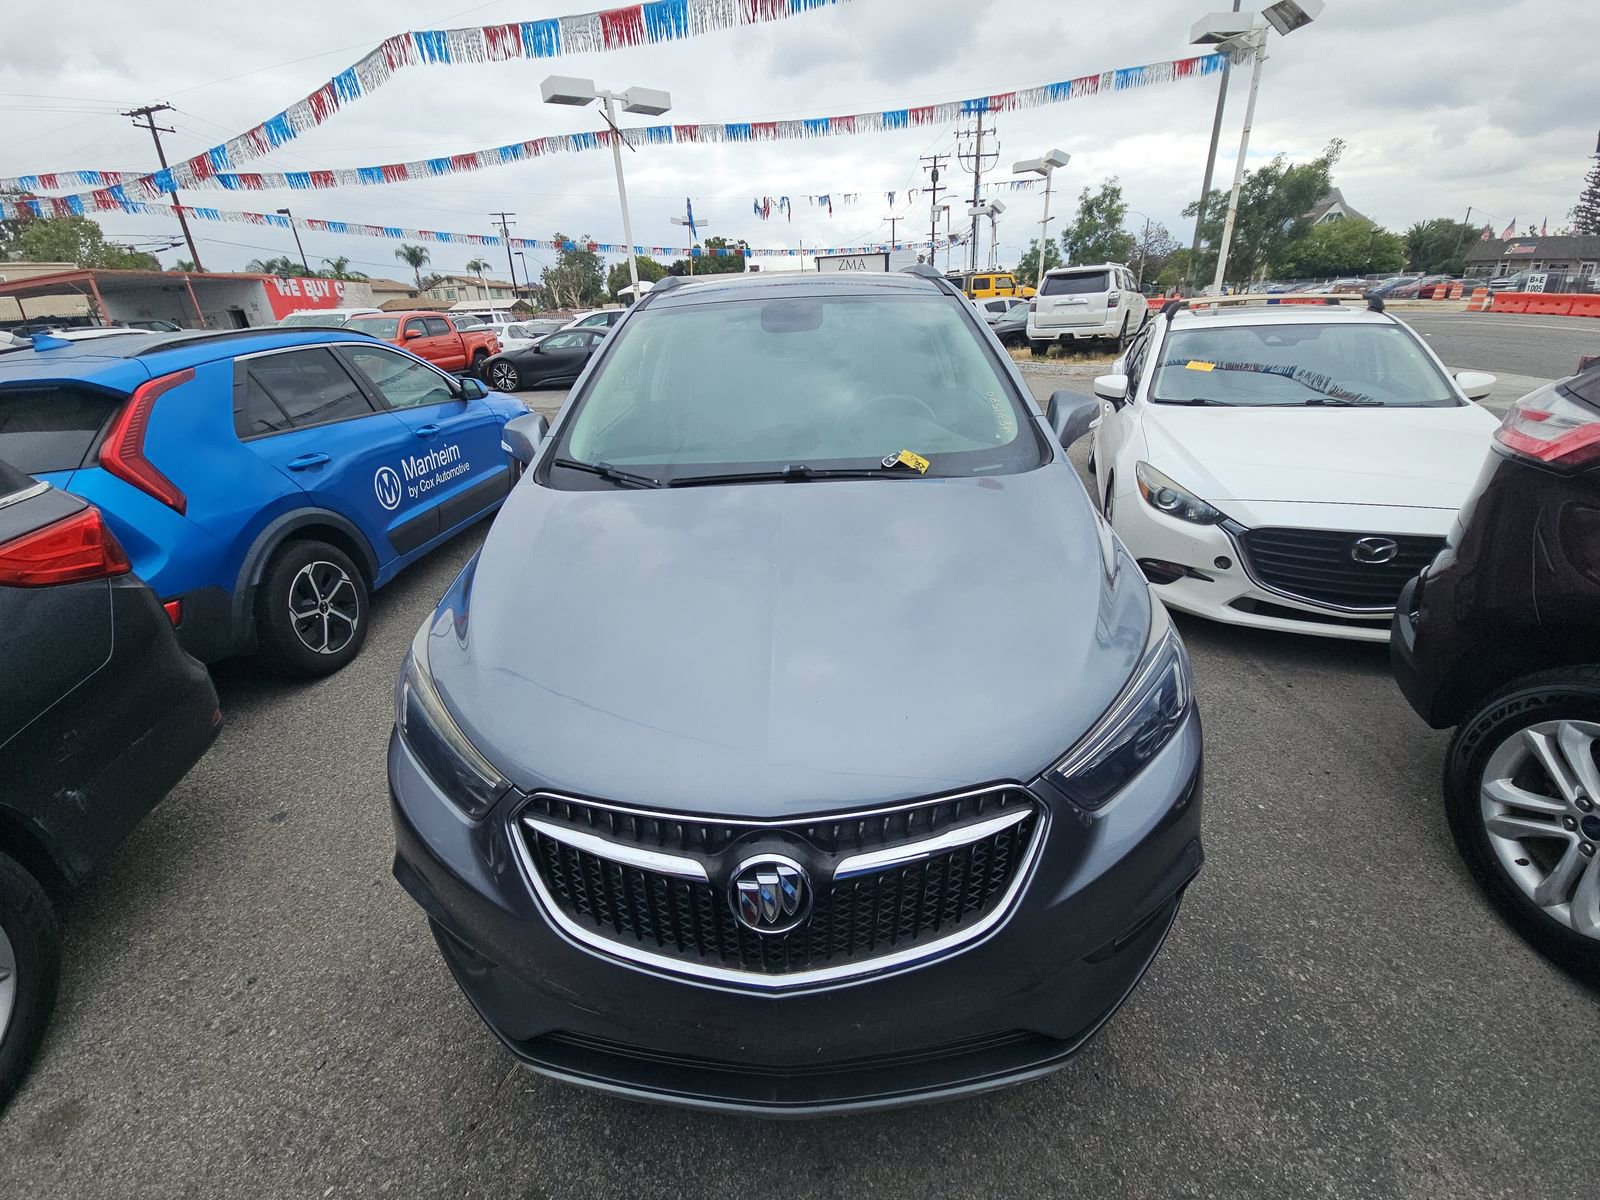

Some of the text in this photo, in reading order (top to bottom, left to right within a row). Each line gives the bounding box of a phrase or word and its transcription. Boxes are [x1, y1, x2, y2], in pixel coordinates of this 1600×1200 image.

[838, 258, 866, 271] ZMA
[273, 278, 301, 296] WE
[302, 279, 331, 297] BUY
[1526, 284, 1543, 293] 1005
[401, 444, 460, 481] Manheim
[408, 462, 470, 499] by Cox Automotive
